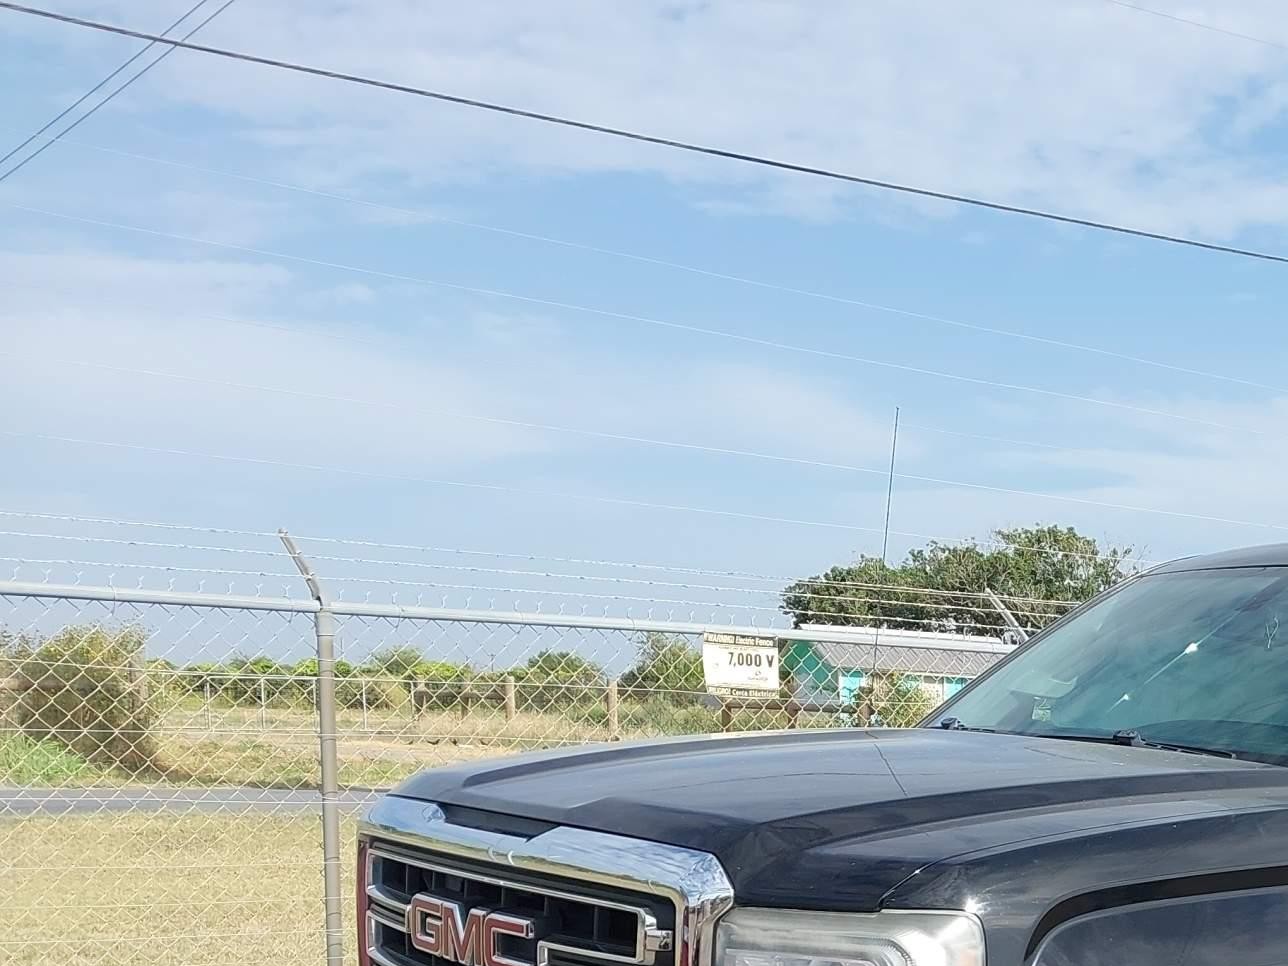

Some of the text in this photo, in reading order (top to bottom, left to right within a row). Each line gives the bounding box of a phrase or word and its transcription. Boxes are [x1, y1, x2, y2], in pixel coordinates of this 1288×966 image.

[755, 638, 774, 647] Fence
[728, 652, 775, 668] 7,000 V
